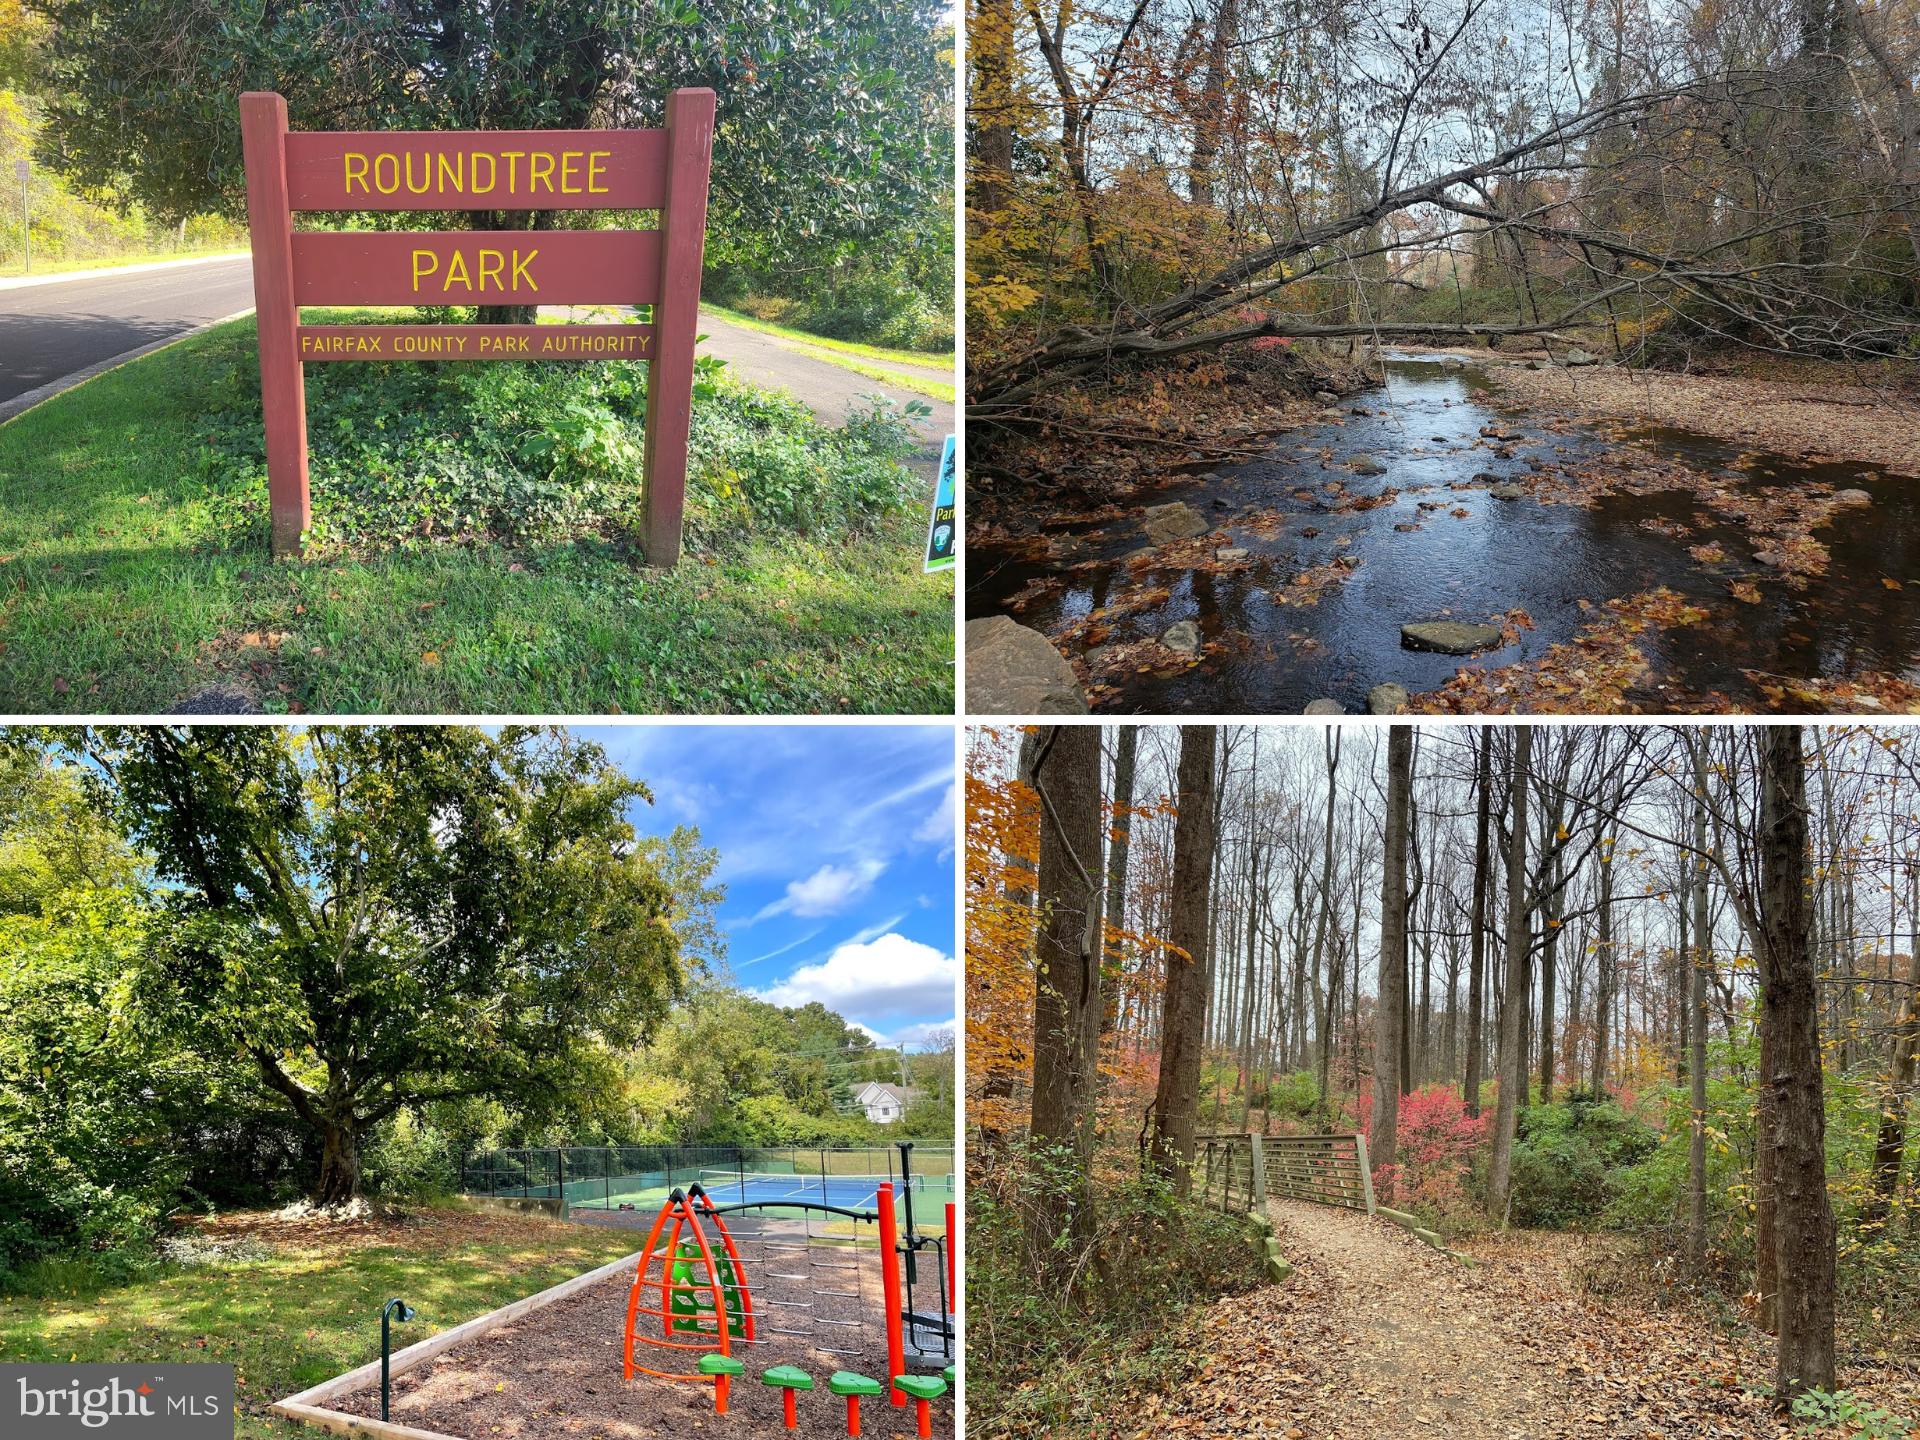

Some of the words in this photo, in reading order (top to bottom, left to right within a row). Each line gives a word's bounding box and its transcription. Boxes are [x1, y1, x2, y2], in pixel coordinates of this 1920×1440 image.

[344, 150, 612, 195] ROUNDTREE
[411, 248, 540, 292] PARK
[301, 335, 382, 353] FAIRFAX
[393, 335, 468, 353] COUNTY
[479, 335, 530, 353] PARK
[542, 335, 651, 353] AUTHORITY
